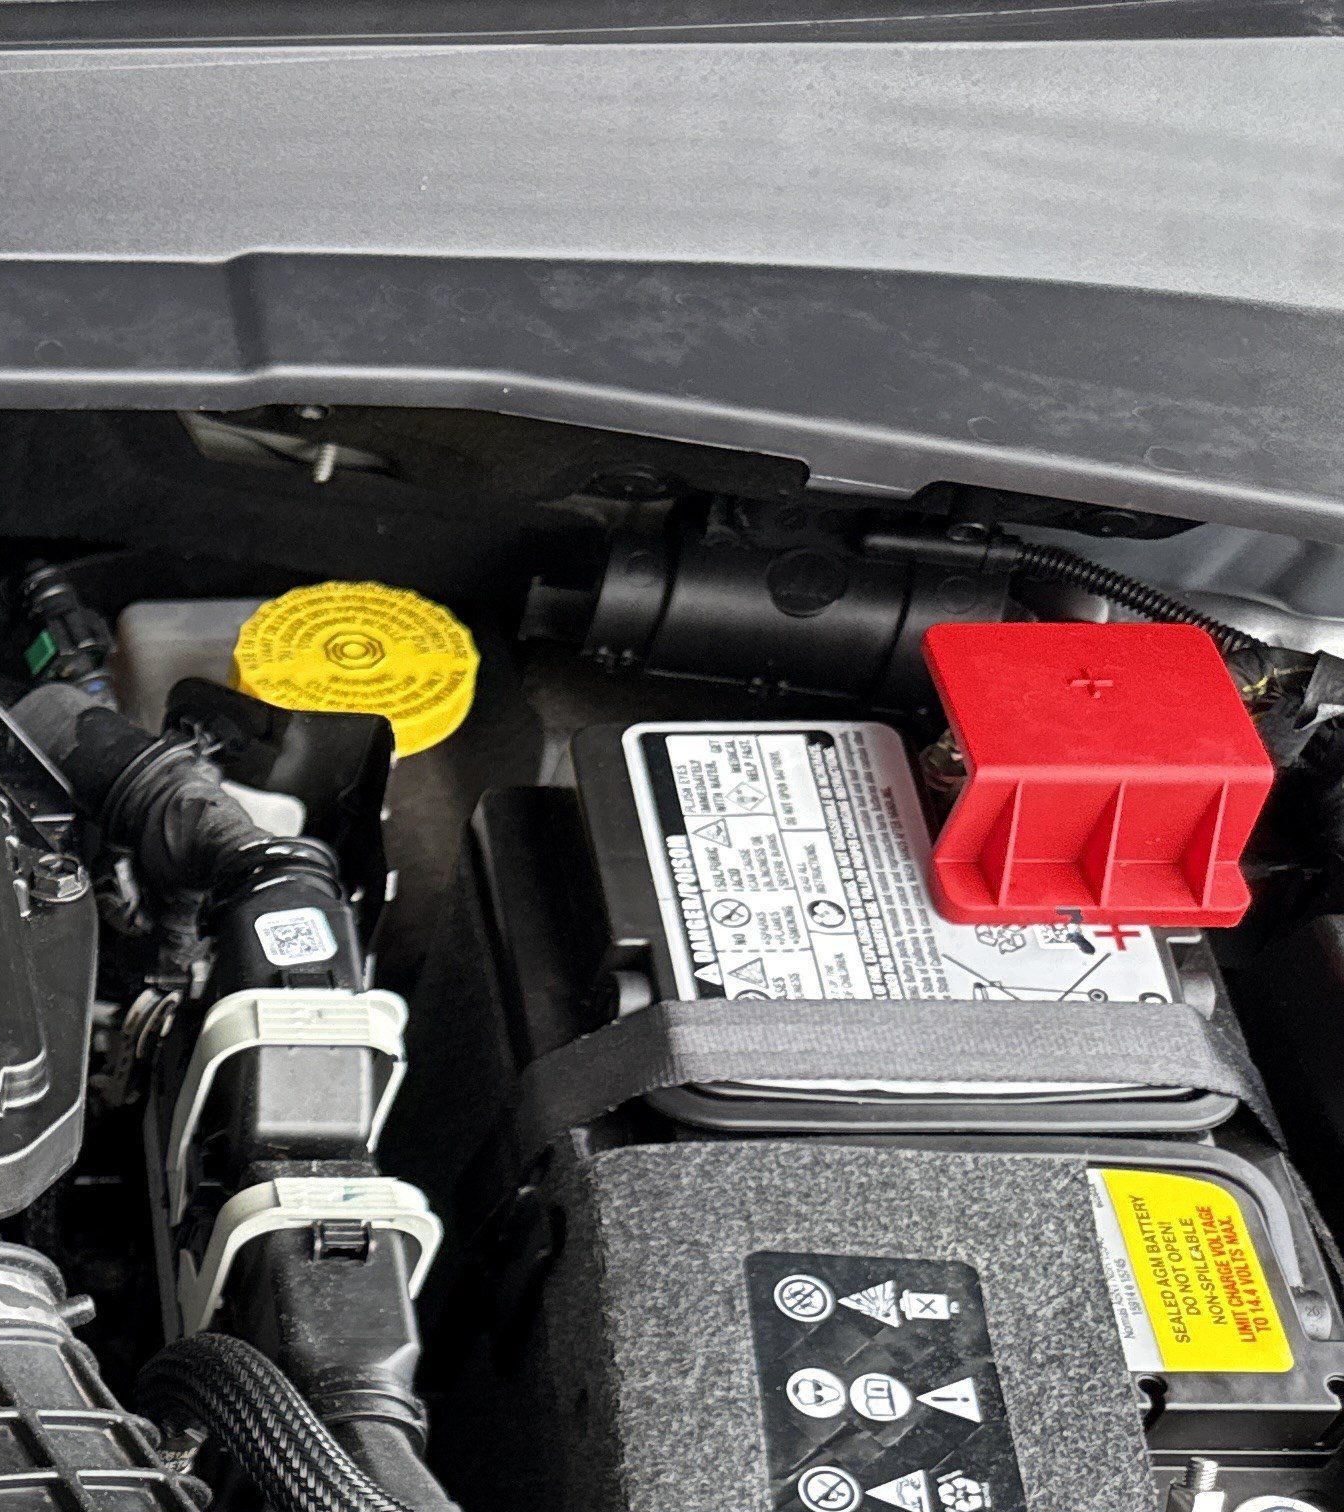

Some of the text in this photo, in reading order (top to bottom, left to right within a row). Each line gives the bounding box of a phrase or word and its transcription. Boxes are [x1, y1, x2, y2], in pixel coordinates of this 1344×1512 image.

[665, 835, 716, 962] DANGER/POISON
[1128, 1194, 1191, 1342] SEALED AGM BATTERY
[1156, 1221, 1201, 1315] DO NOT OPEN!
[1195, 1205, 1256, 1342] LIMIT CHARGE VOLTAGE
[1216, 1215, 1271, 1332] TO 14.4 VOLTS MAX.
